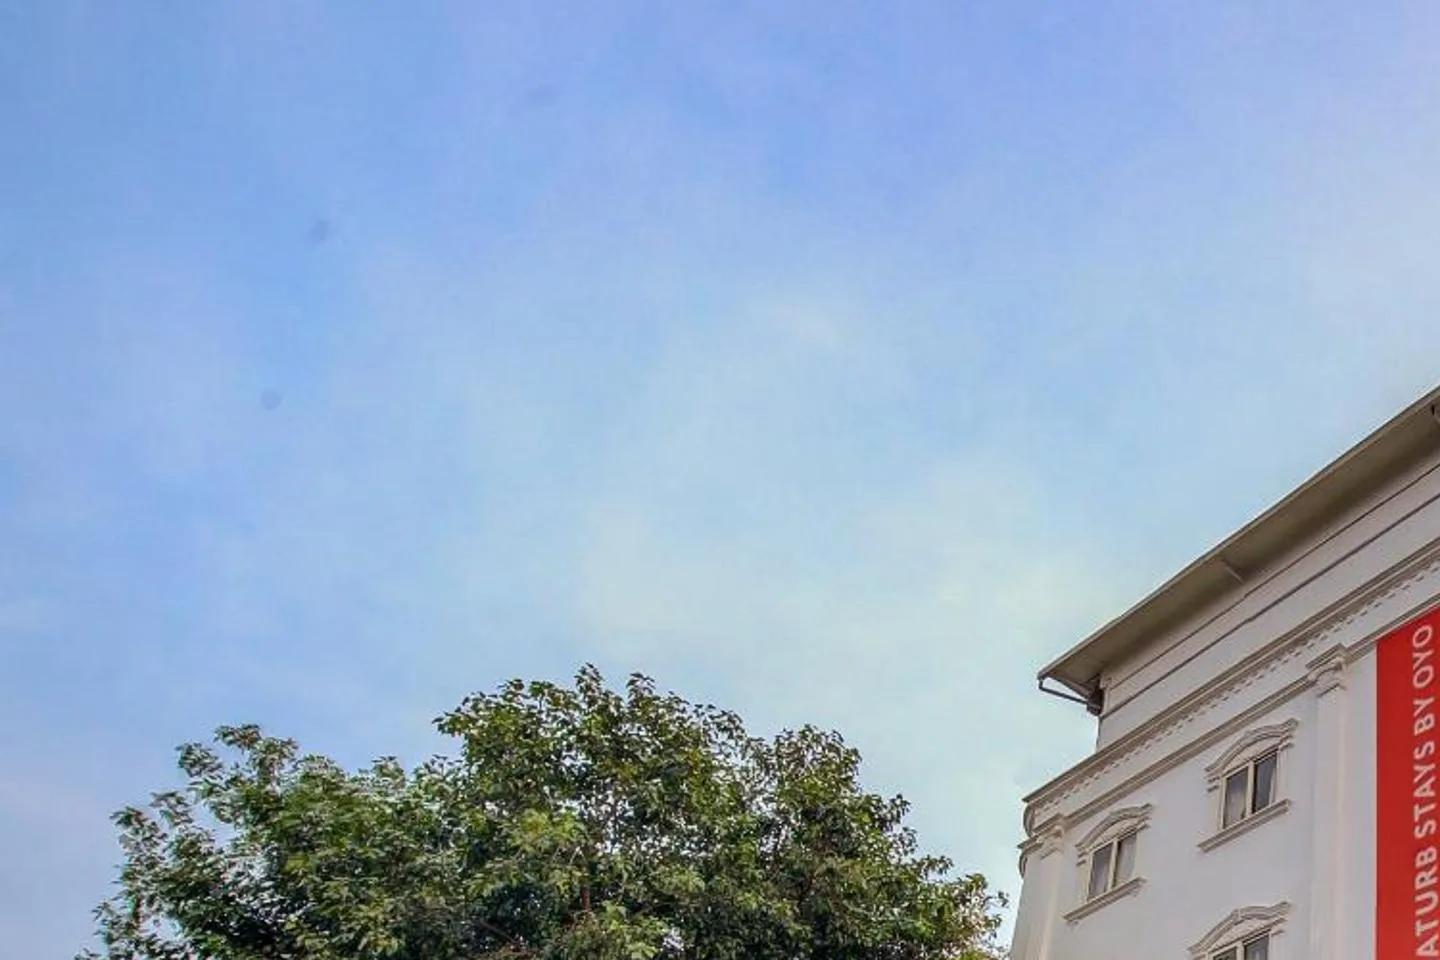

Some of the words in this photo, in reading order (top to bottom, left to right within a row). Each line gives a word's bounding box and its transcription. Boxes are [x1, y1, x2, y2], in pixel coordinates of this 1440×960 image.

[1411, 623, 1435, 689] OYO
[1412, 696, 1436, 736] BY
[1412, 739, 1437, 839] STAYS
